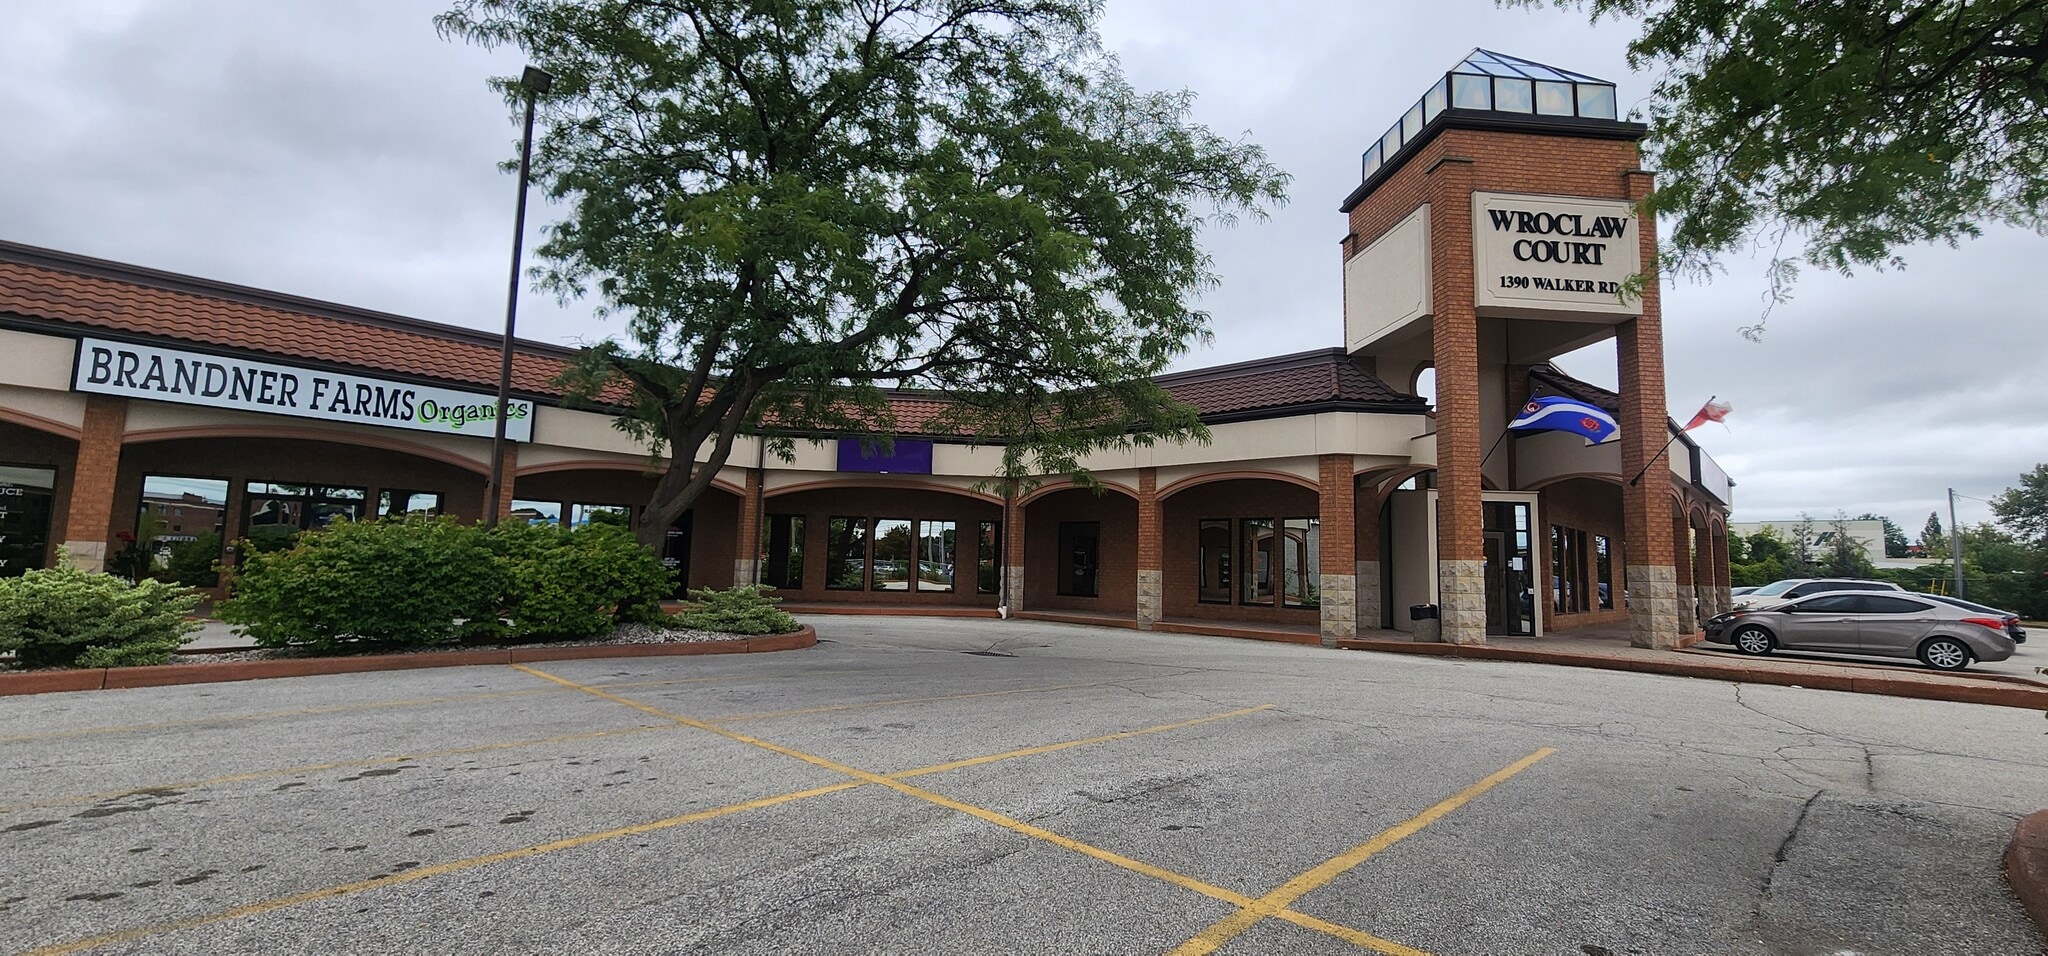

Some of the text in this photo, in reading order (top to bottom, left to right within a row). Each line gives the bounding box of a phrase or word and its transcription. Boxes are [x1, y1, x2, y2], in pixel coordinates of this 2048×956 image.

[1488, 209, 1628, 239] WROCLAW
[1513, 239, 1606, 265] COURT
[1500, 275, 1529, 289] 1390
[1532, 277, 1595, 293] WALKER
[87, 347, 528, 428] BRANDNER FARMS Organcs
